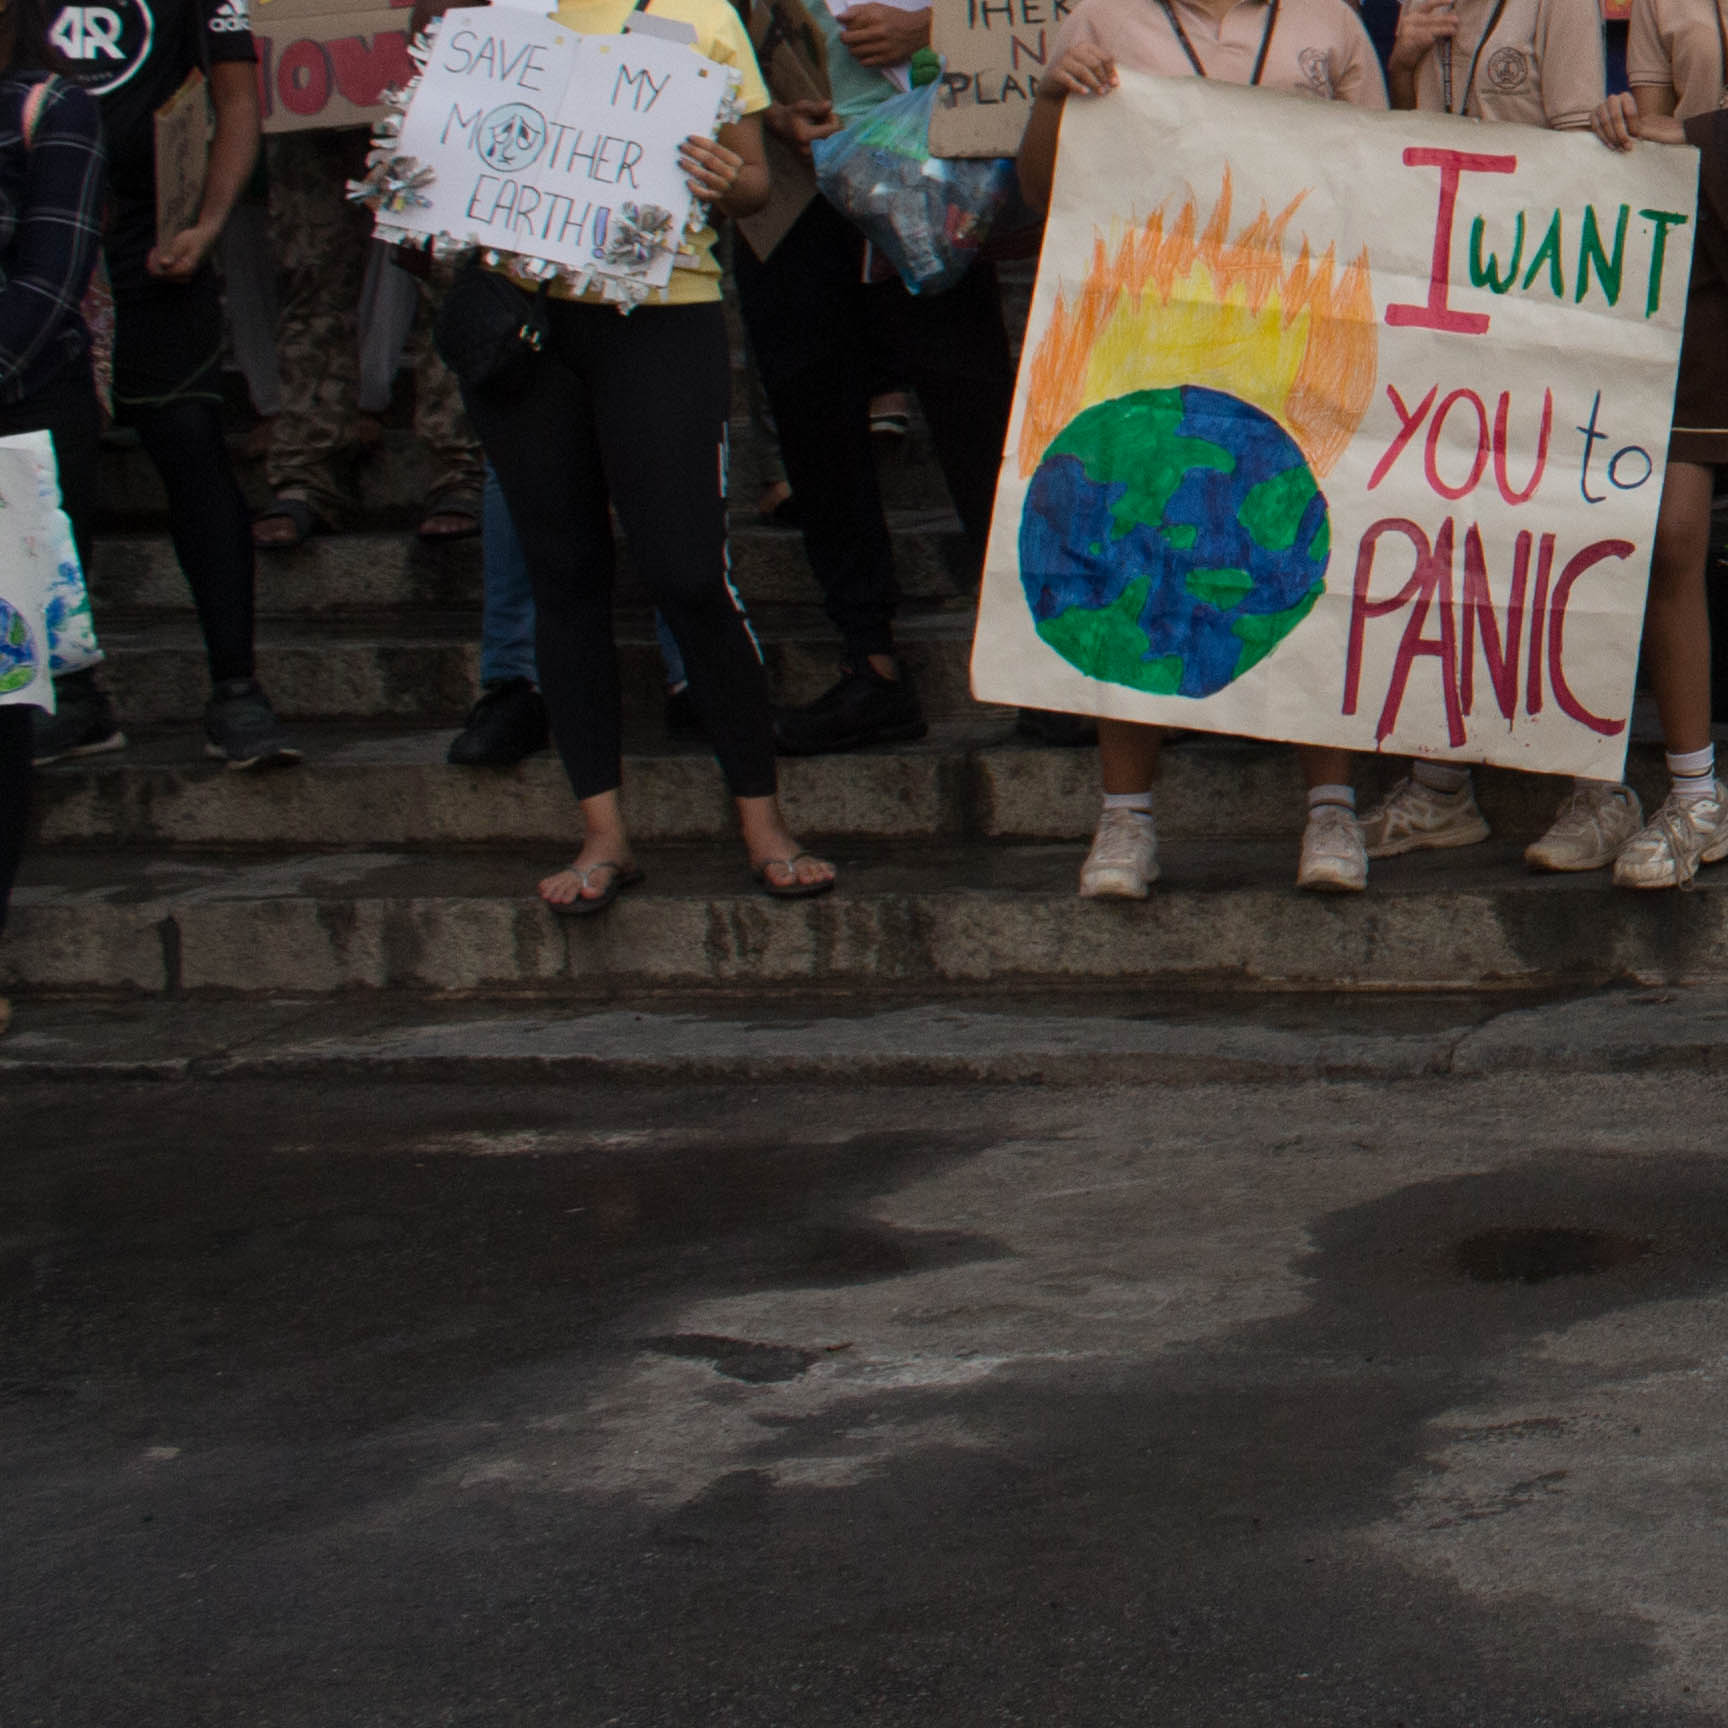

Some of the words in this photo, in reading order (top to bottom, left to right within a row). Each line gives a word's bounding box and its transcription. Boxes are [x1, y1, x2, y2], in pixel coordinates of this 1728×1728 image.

[445, 30, 548, 92] SAVE
[611, 63, 671, 113] MY
[1011, 27, 1047, 71] N
[466, 173, 611, 259] EARTH!
[1384, 146, 1517, 335] I
[1468, 202, 1688, 318] WANT
[1368, 383, 1554, 506] YOU
[1575, 390, 1653, 504] to
[1341, 516, 1637, 749] PANIC
